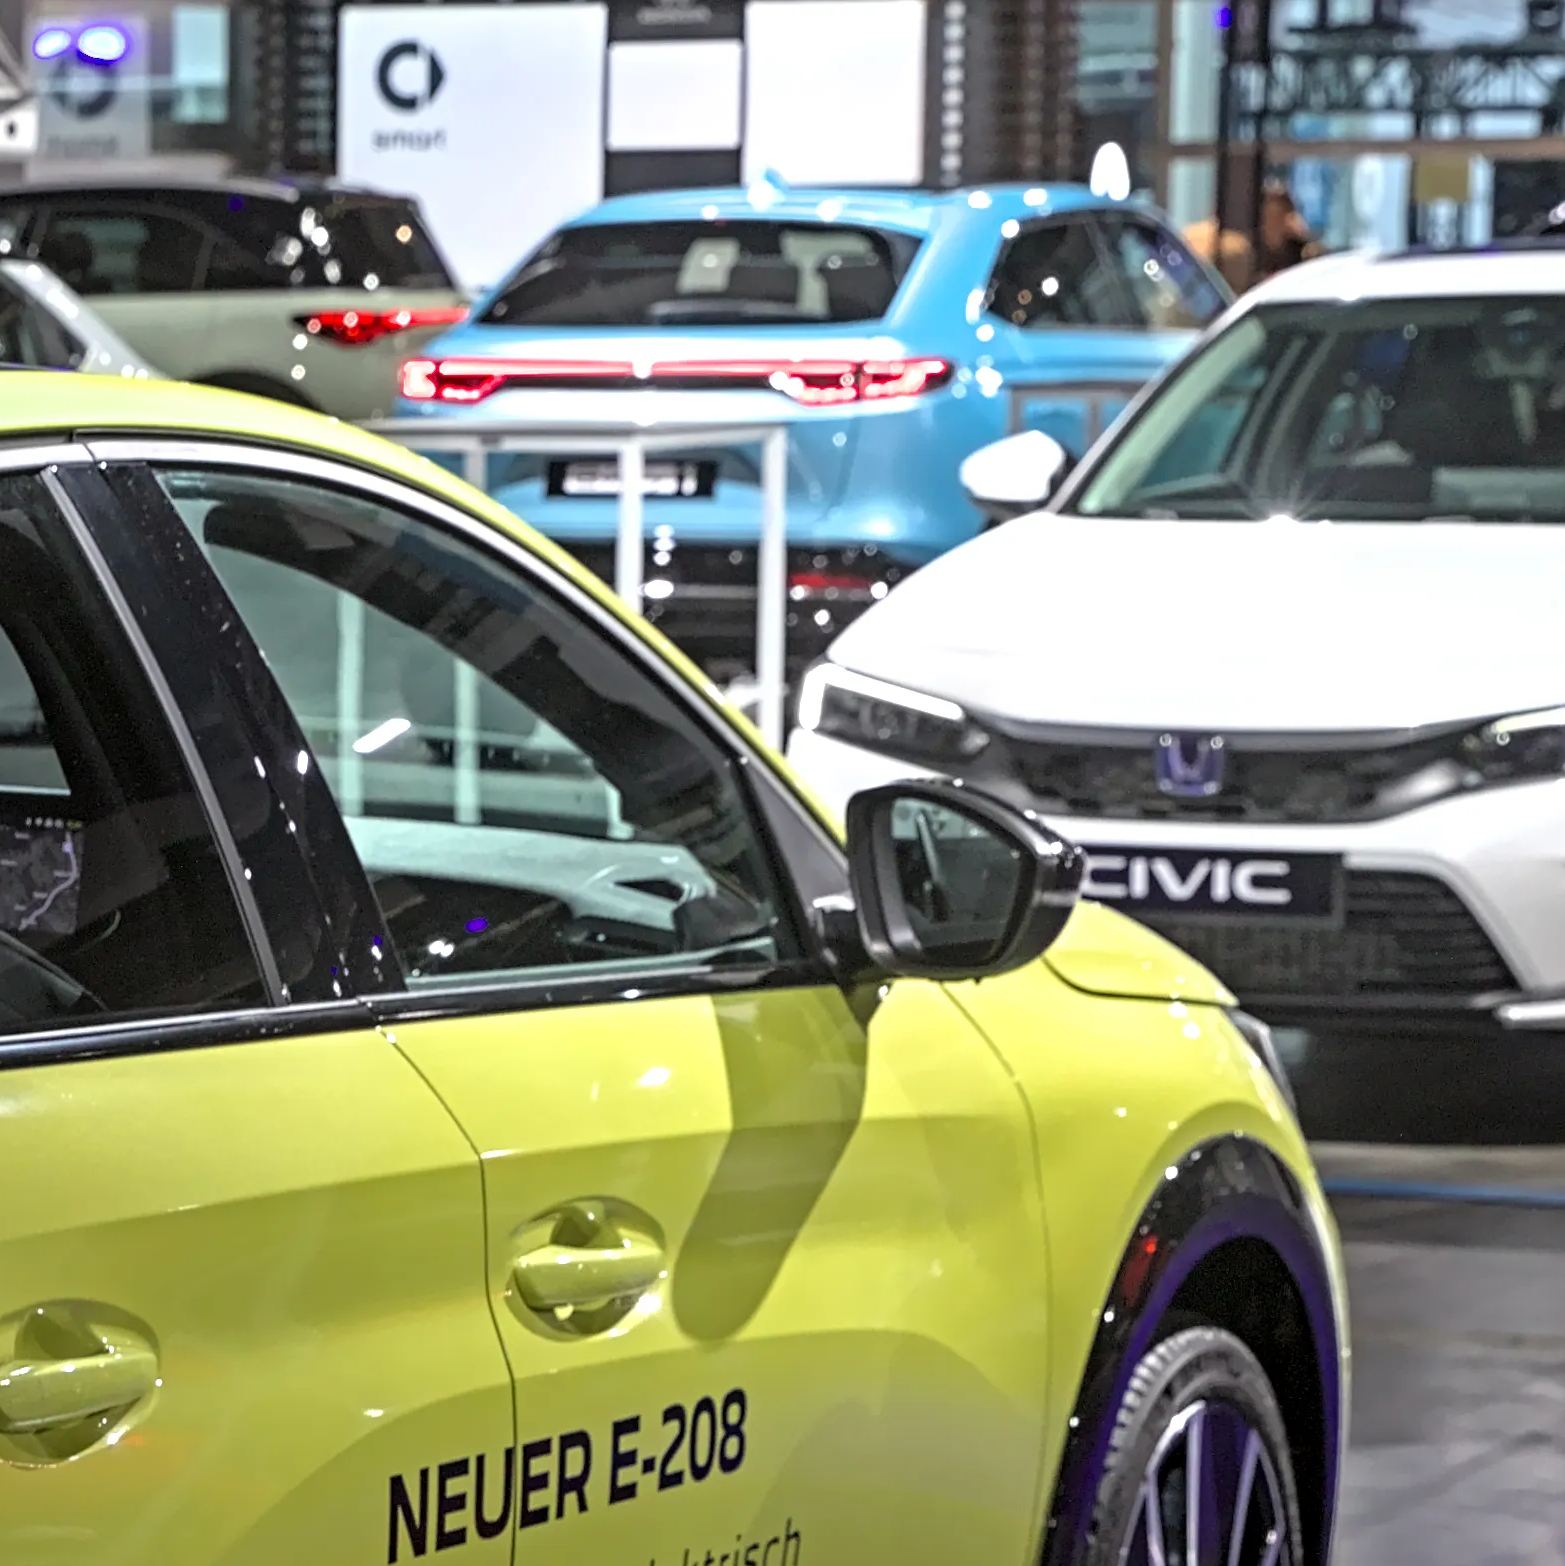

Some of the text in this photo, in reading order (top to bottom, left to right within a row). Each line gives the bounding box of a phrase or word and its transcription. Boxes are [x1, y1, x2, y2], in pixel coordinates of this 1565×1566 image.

[1080, 854, 1292, 904] CIVIC
[386, 1388, 747, 1566] NEUER E-208
